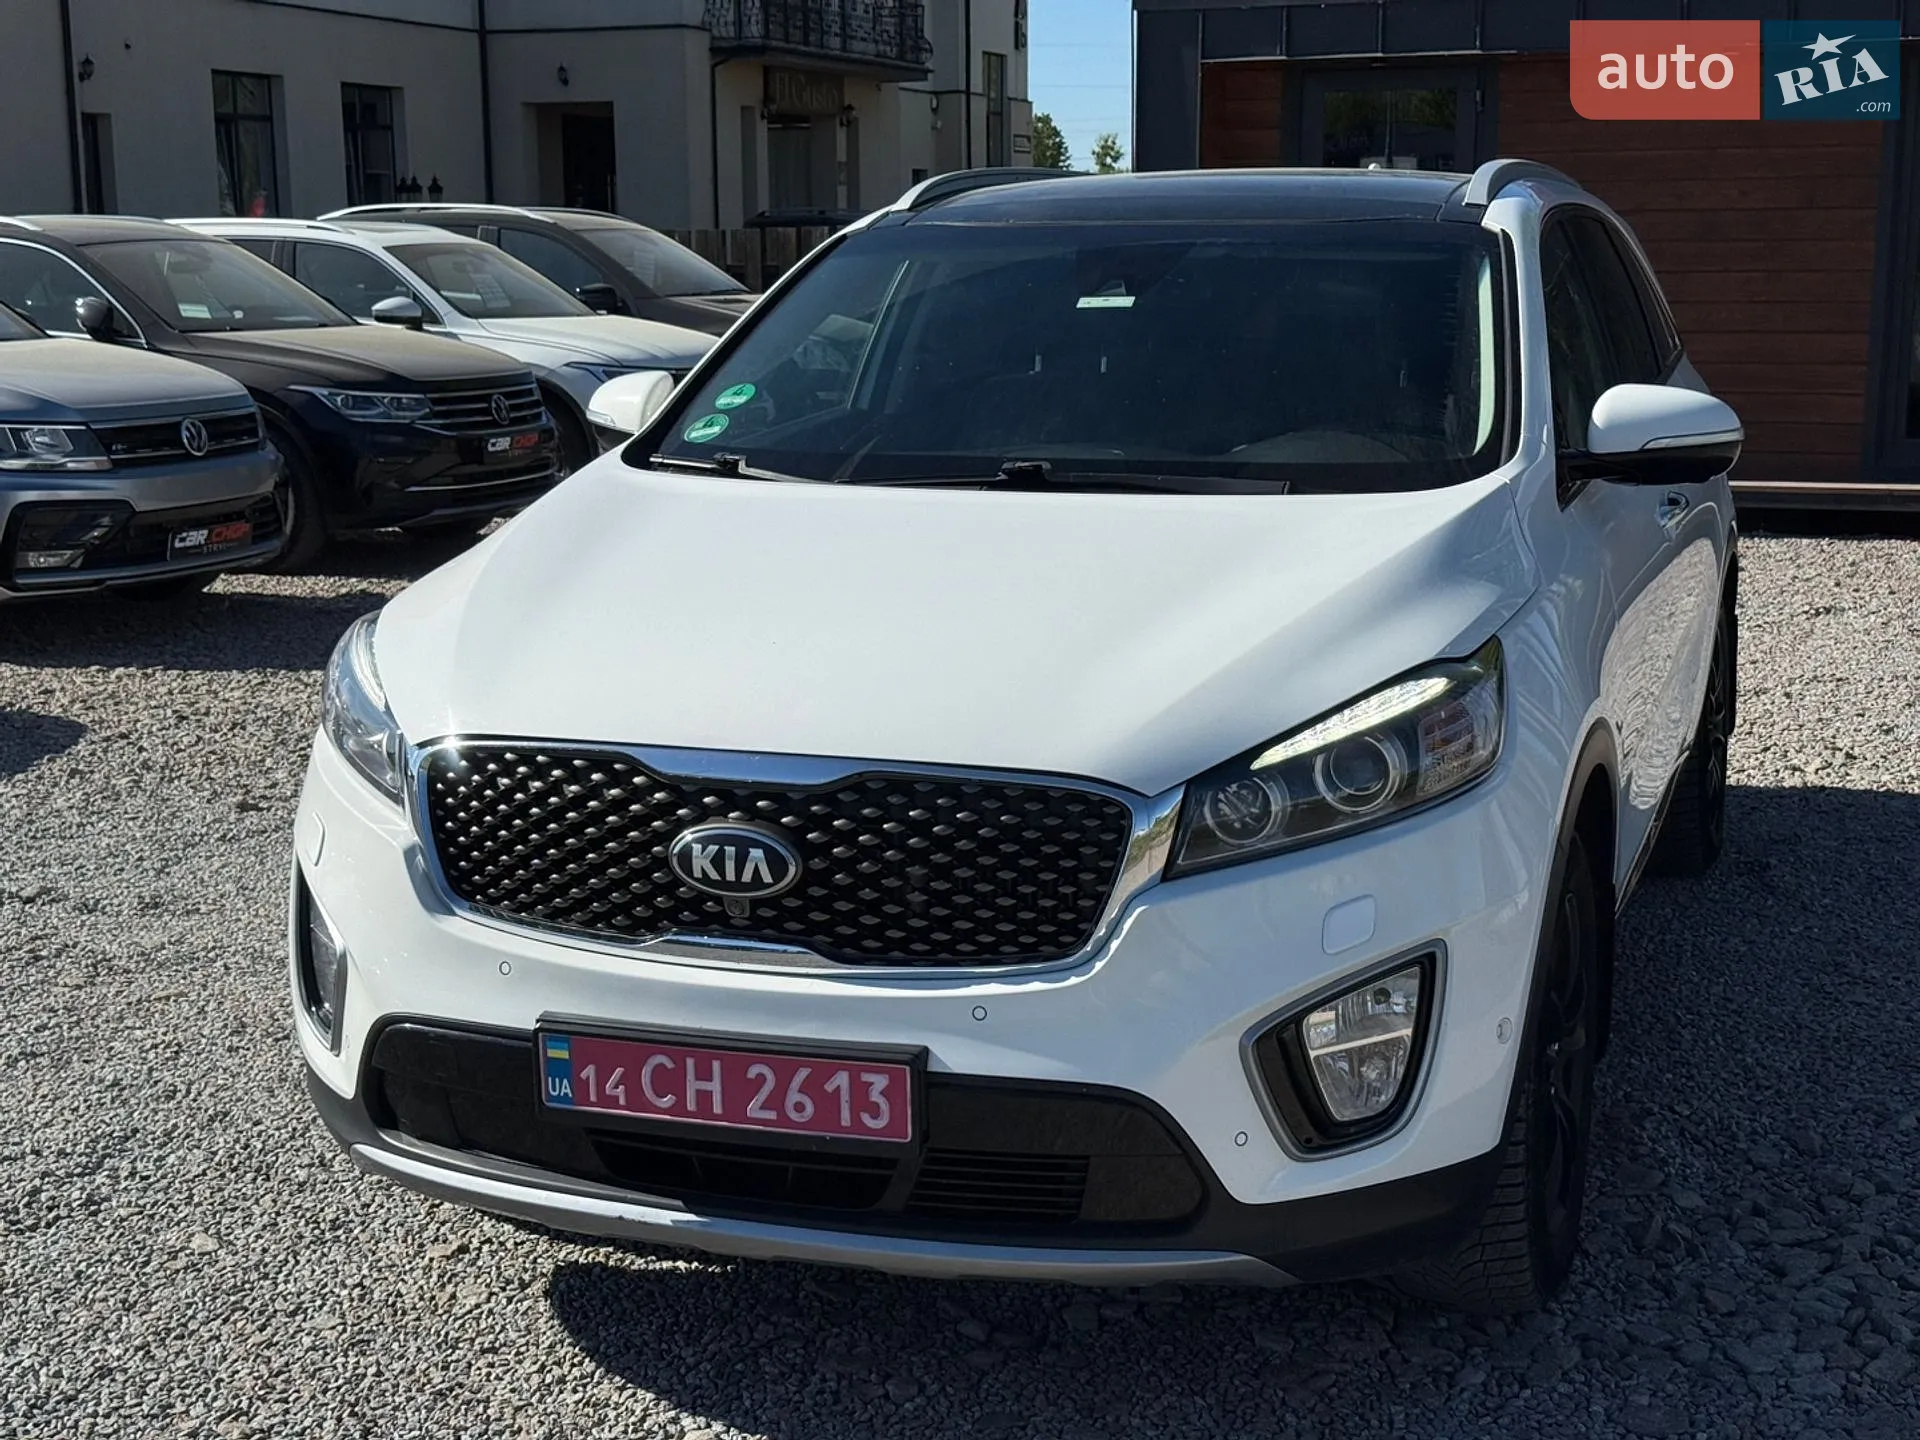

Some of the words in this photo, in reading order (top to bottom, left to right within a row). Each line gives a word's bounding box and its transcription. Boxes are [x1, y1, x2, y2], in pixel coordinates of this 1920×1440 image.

[691, 843, 774, 884] KIA
[548, 1076, 573, 1098] UA
[746, 1063, 890, 1130] 2613
